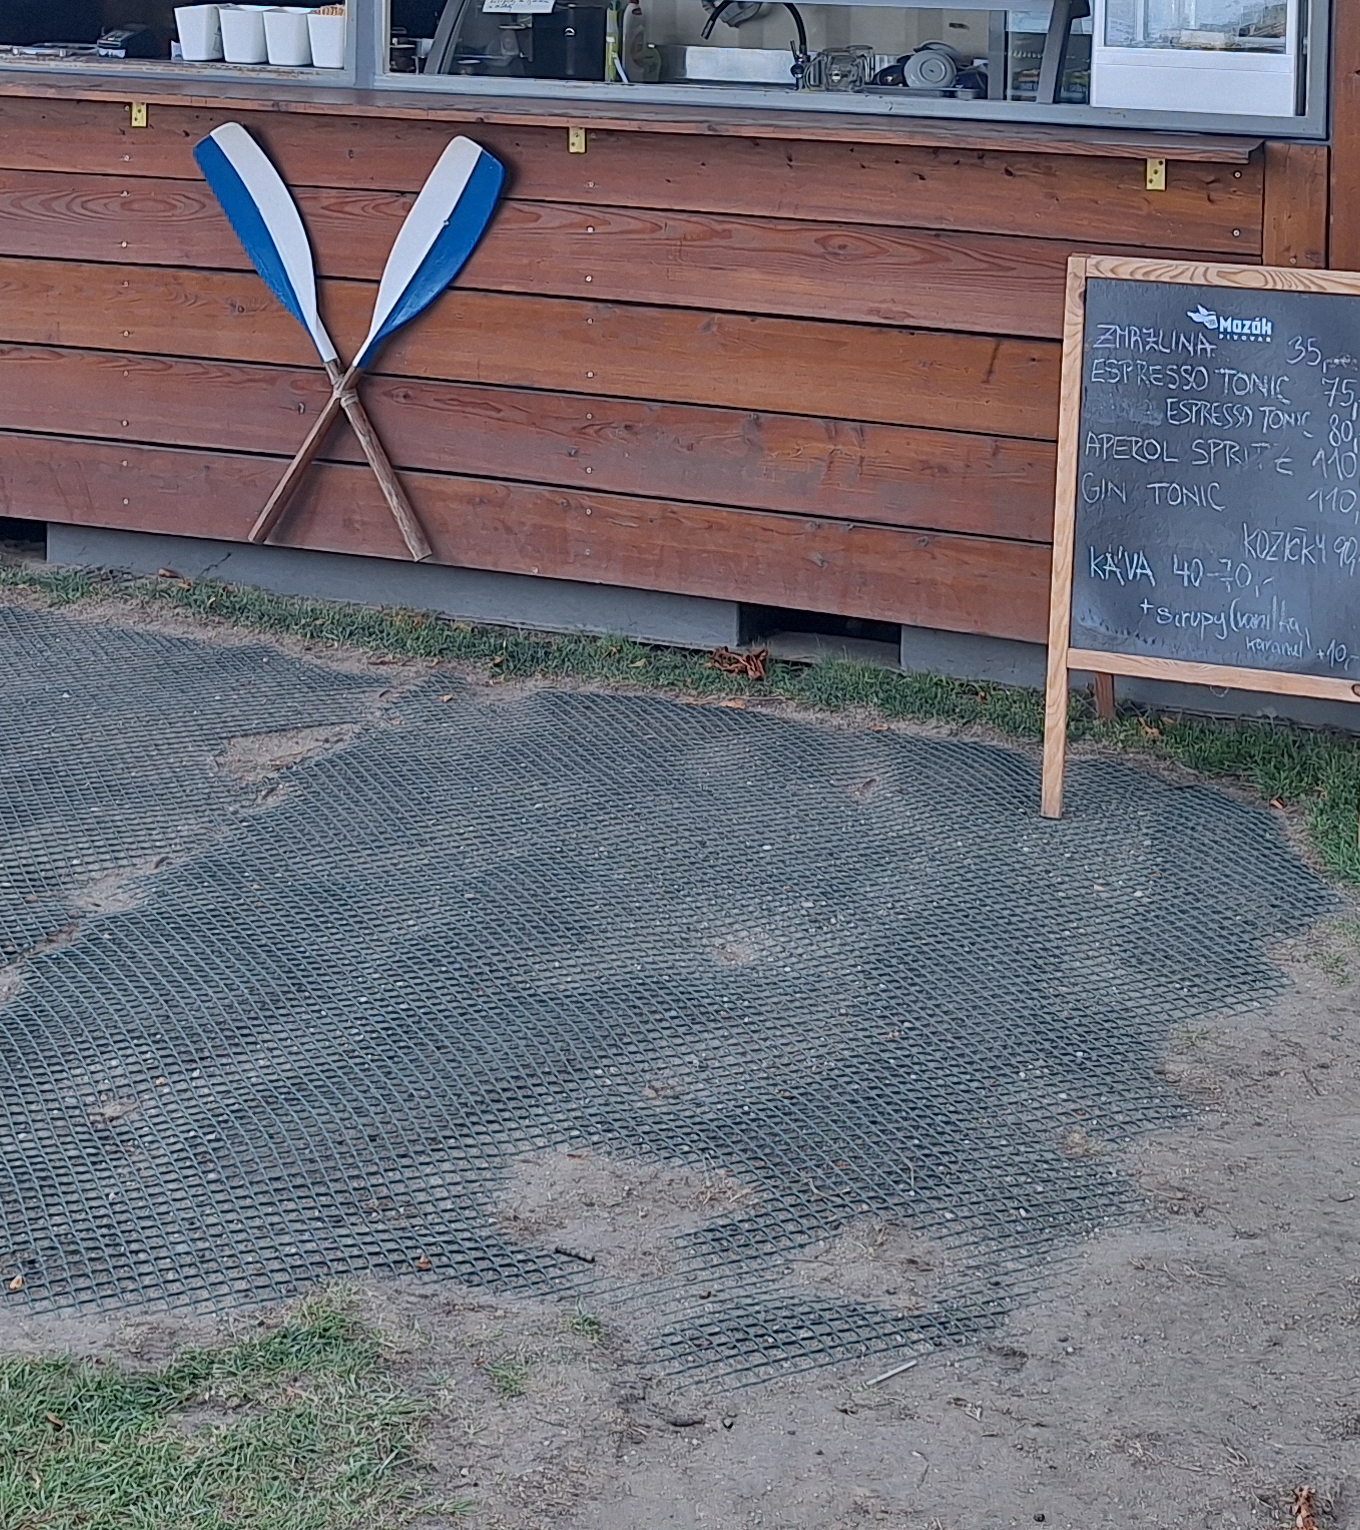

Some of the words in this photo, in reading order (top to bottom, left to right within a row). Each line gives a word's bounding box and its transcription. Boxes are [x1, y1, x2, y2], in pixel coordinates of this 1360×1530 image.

[1219, 316, 1272, 335] Mazák
[1091, 358, 1210, 391] ESPRESSO
[1214, 368, 1291, 404] TONIC
[1165, 398, 1253, 430] ESPRESSO
[1258, 405, 1314, 438] TONIC
[1085, 430, 1179, 464] APEROL
[1081, 471, 1127, 505] GIN
[1146, 481, 1226, 512] TONIC
[1090, 544, 1156, 588] KÁVA
